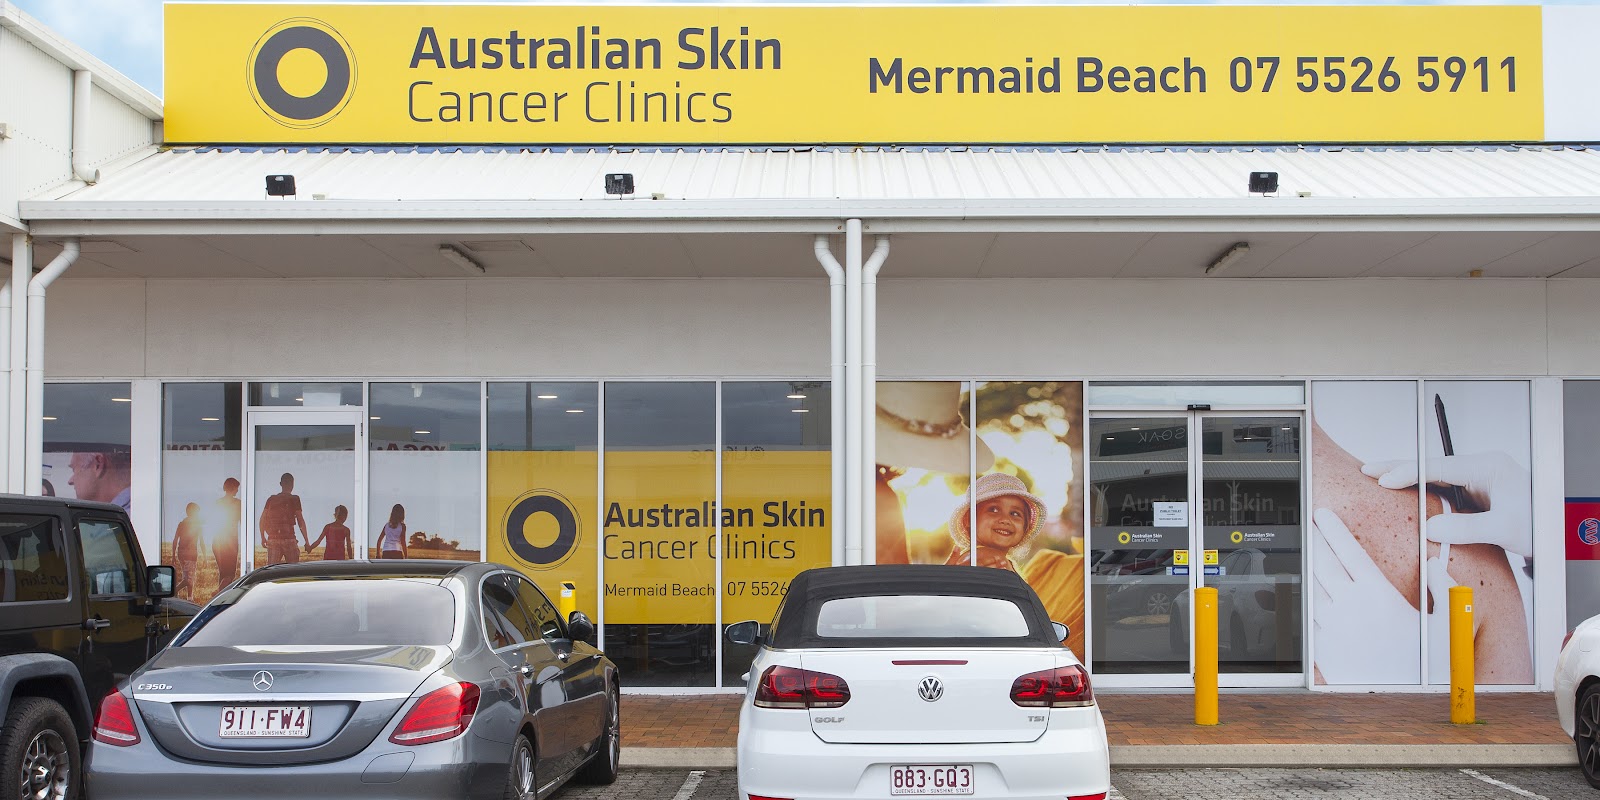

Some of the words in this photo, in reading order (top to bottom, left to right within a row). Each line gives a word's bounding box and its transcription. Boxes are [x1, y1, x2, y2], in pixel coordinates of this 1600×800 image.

[409, 26, 661, 70] Australian
[678, 26, 781, 70] Skin
[868, 57, 1061, 93] Mermaid
[1077, 57, 1207, 93] Beach
[1229, 57, 1281, 93] 07
[1297, 57, 1401, 93] 5526
[1418, 56, 1517, 93] 5911
[408, 81, 568, 123] Cancer
[585, 80, 733, 123] Clinics
[603, 501, 754, 528] Australian
[763, 501, 825, 528] Skin
[603, 534, 698, 560] Cancer
[707, 533, 796, 560] Clinics
[605, 583, 667, 597] Mermaid
[672, 583, 715, 597] Beach
[727, 581, 746, 596] 07
[751, 581, 789, 596] 5526
